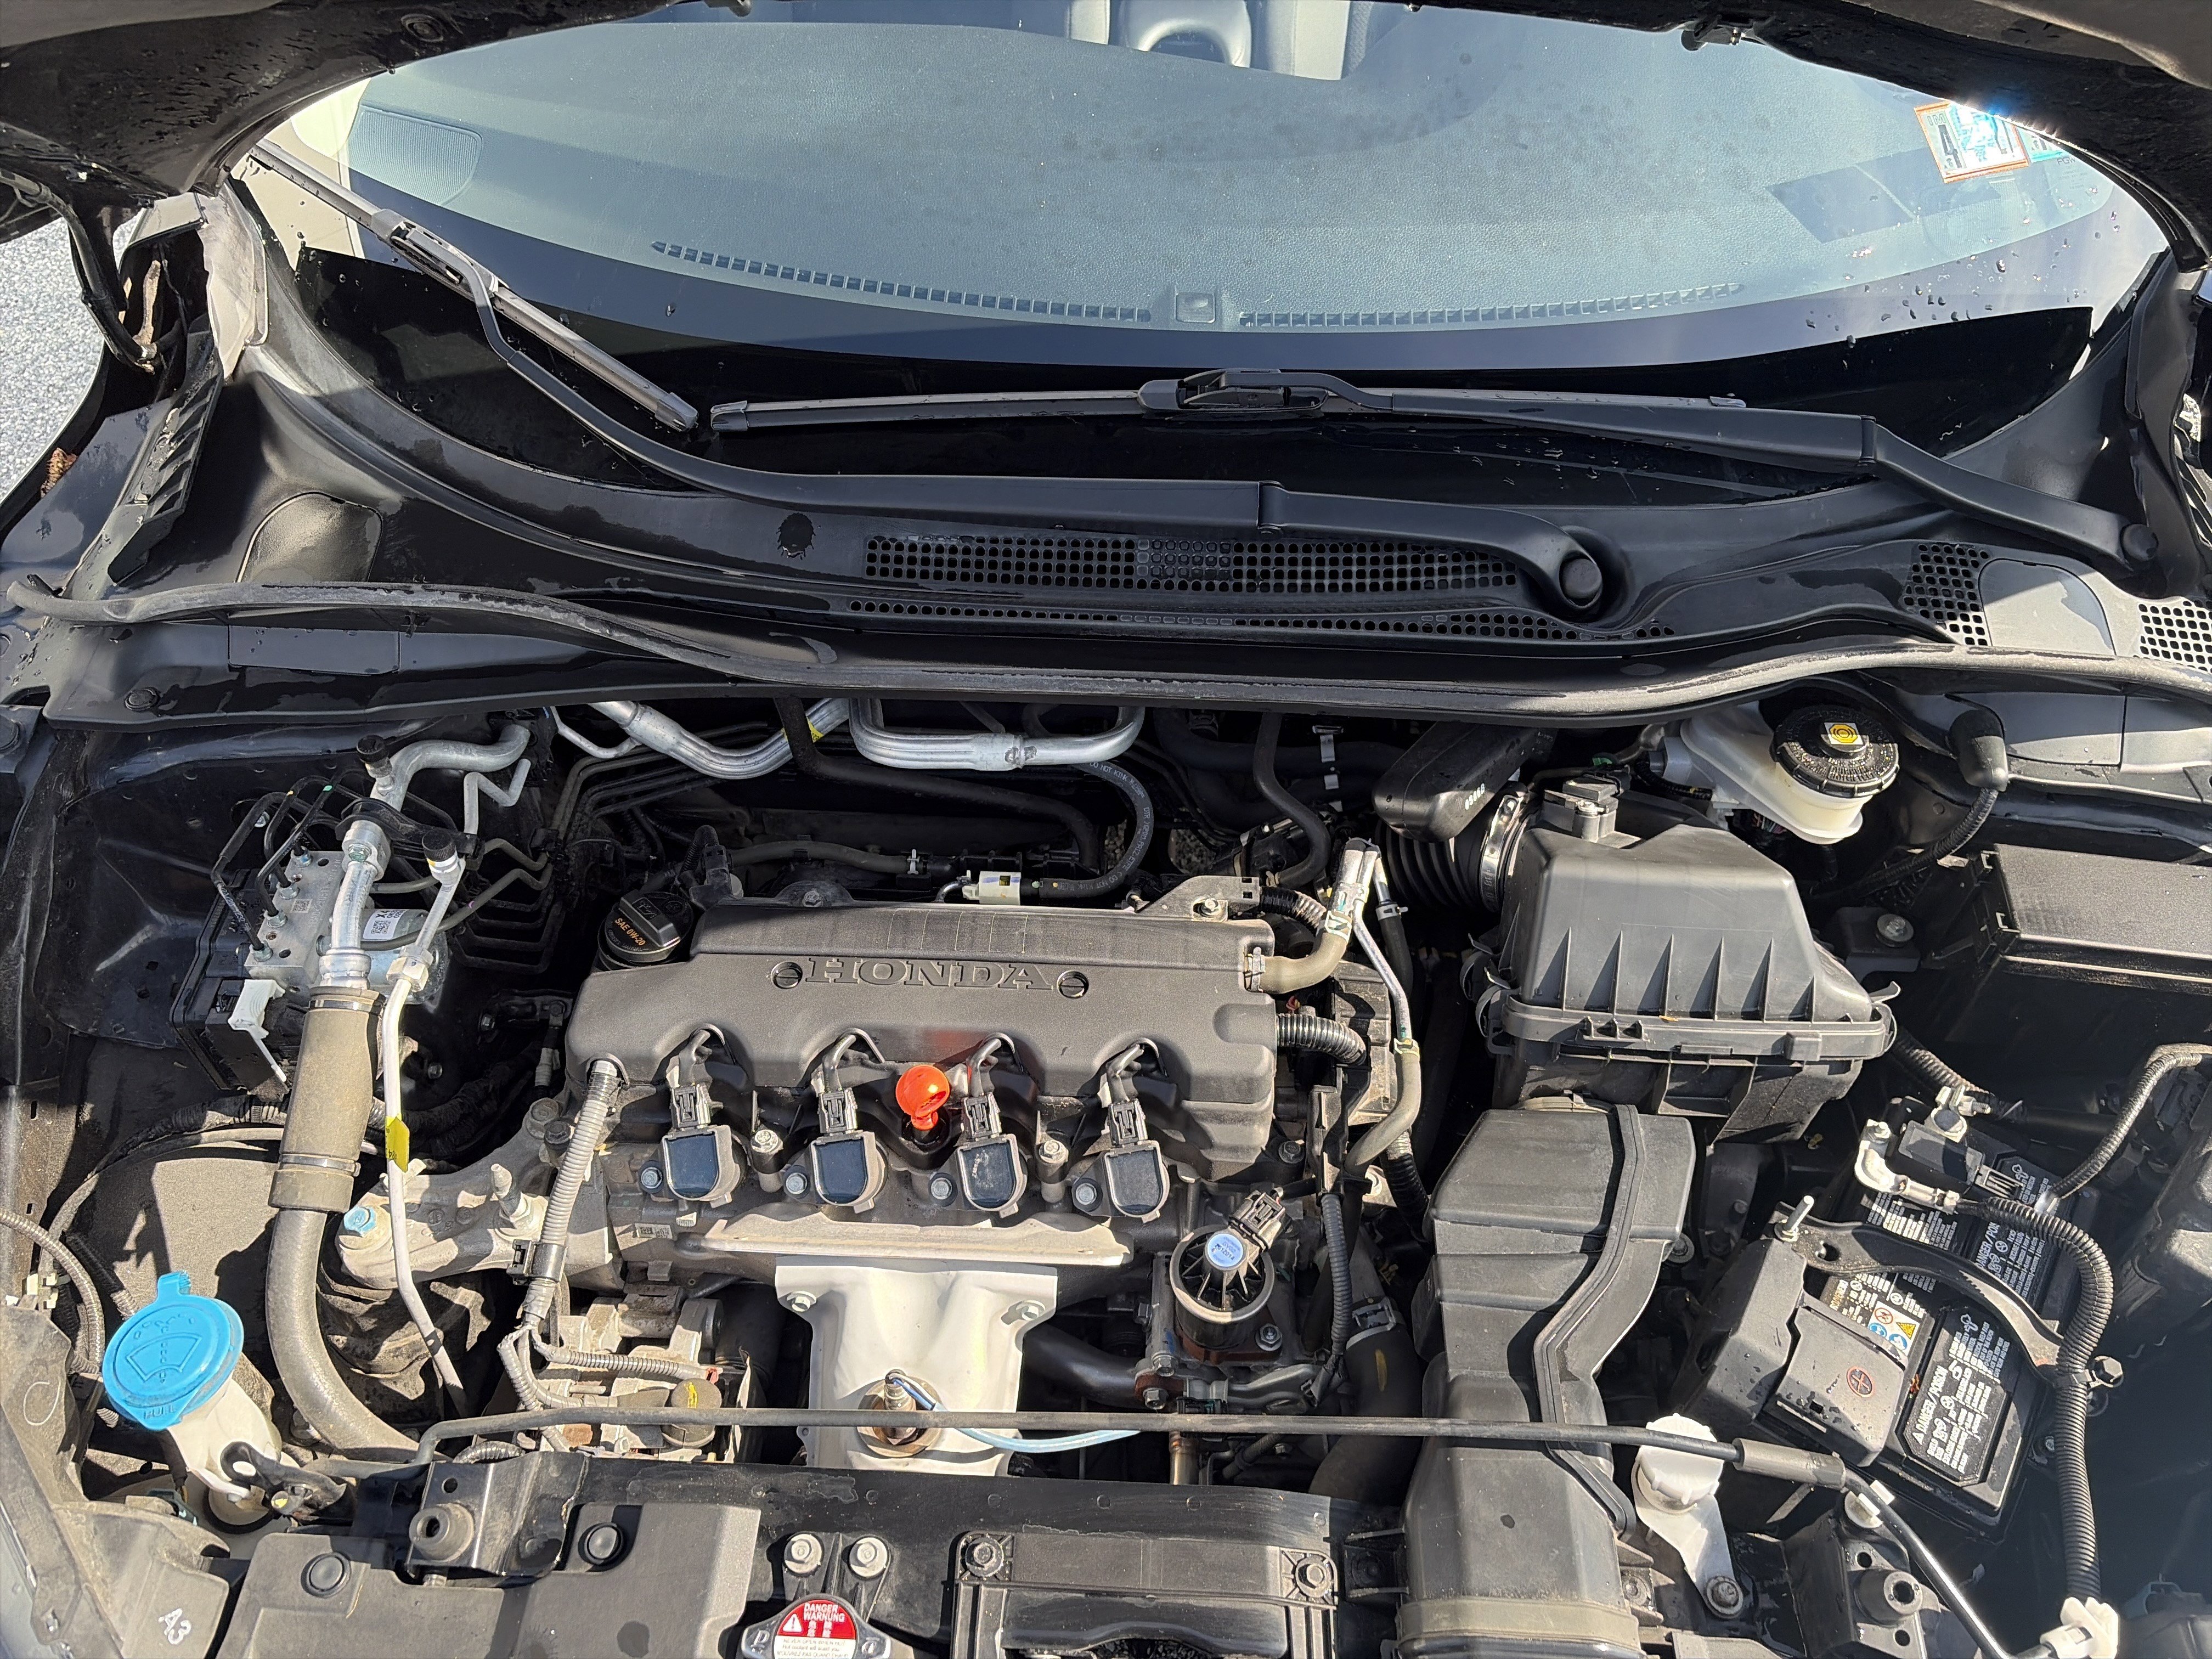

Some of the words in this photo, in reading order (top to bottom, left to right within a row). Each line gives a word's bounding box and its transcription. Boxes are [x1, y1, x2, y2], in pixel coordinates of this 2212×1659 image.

[1100, 765, 1113, 774] NOT
[1114, 770, 1128, 782] KINK
[614, 918, 630, 931] SAE
[627, 929, 646, 946] 0W-20
[806, 957, 1053, 990] HONDA
[804, 1602, 838, 1613] DANGER
[158, 1608, 191, 1645] A3
